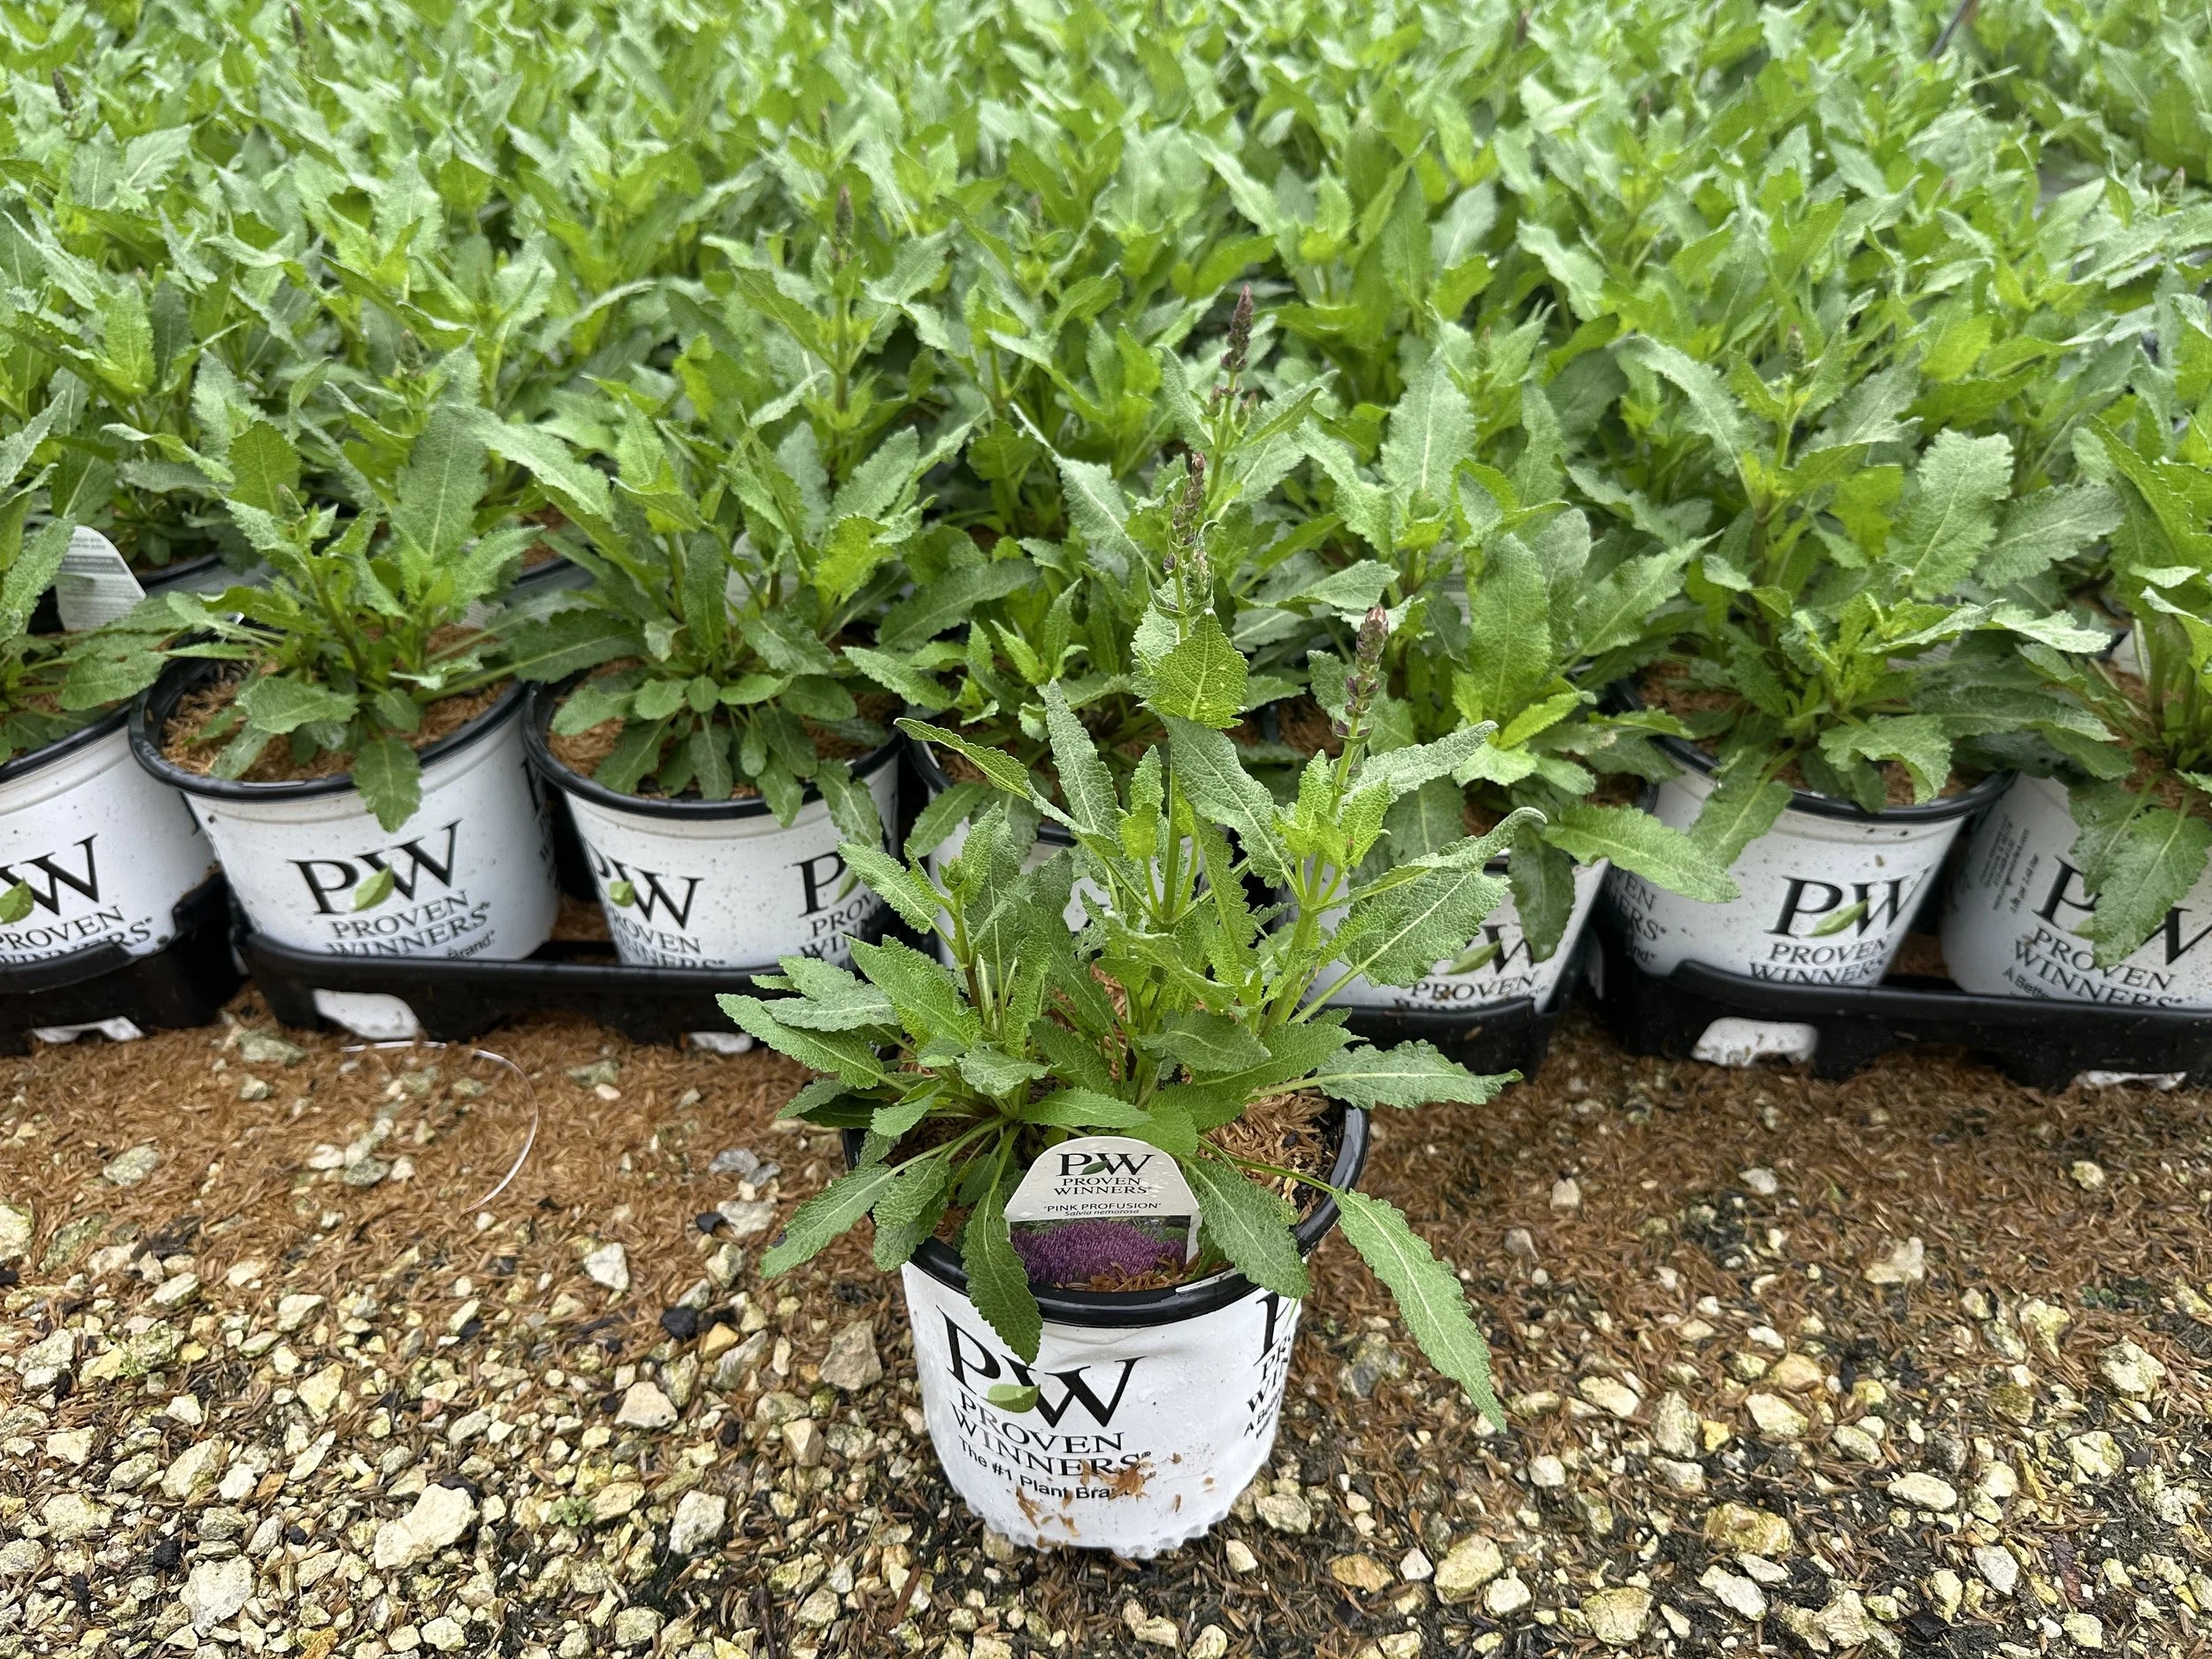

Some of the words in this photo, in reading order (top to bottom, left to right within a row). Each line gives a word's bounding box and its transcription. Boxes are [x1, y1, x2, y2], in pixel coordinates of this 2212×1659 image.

[0, 833, 99, 916] W
[286, 818, 464, 916] PW
[792, 850, 849, 918] P
[0, 904, 125, 950] ROVEN
[328, 889, 470, 939] PROVEN
[1770, 938, 1887, 965] PROVEN
[1410, 970, 1540, 1002] PROVEN
[1056, 1153, 1156, 1177] PW
[1062, 1177, 1141, 1187] PROVEN
[935, 1304, 1148, 1428] PW
[957, 1387, 1125, 1454] PROVEN
[958, 1434, 987, 1467] The
[992, 1463, 1013, 1480] #1
[1020, 1474, 1069, 1497] Plant
[1076, 1485, 1135, 1499] Bra
